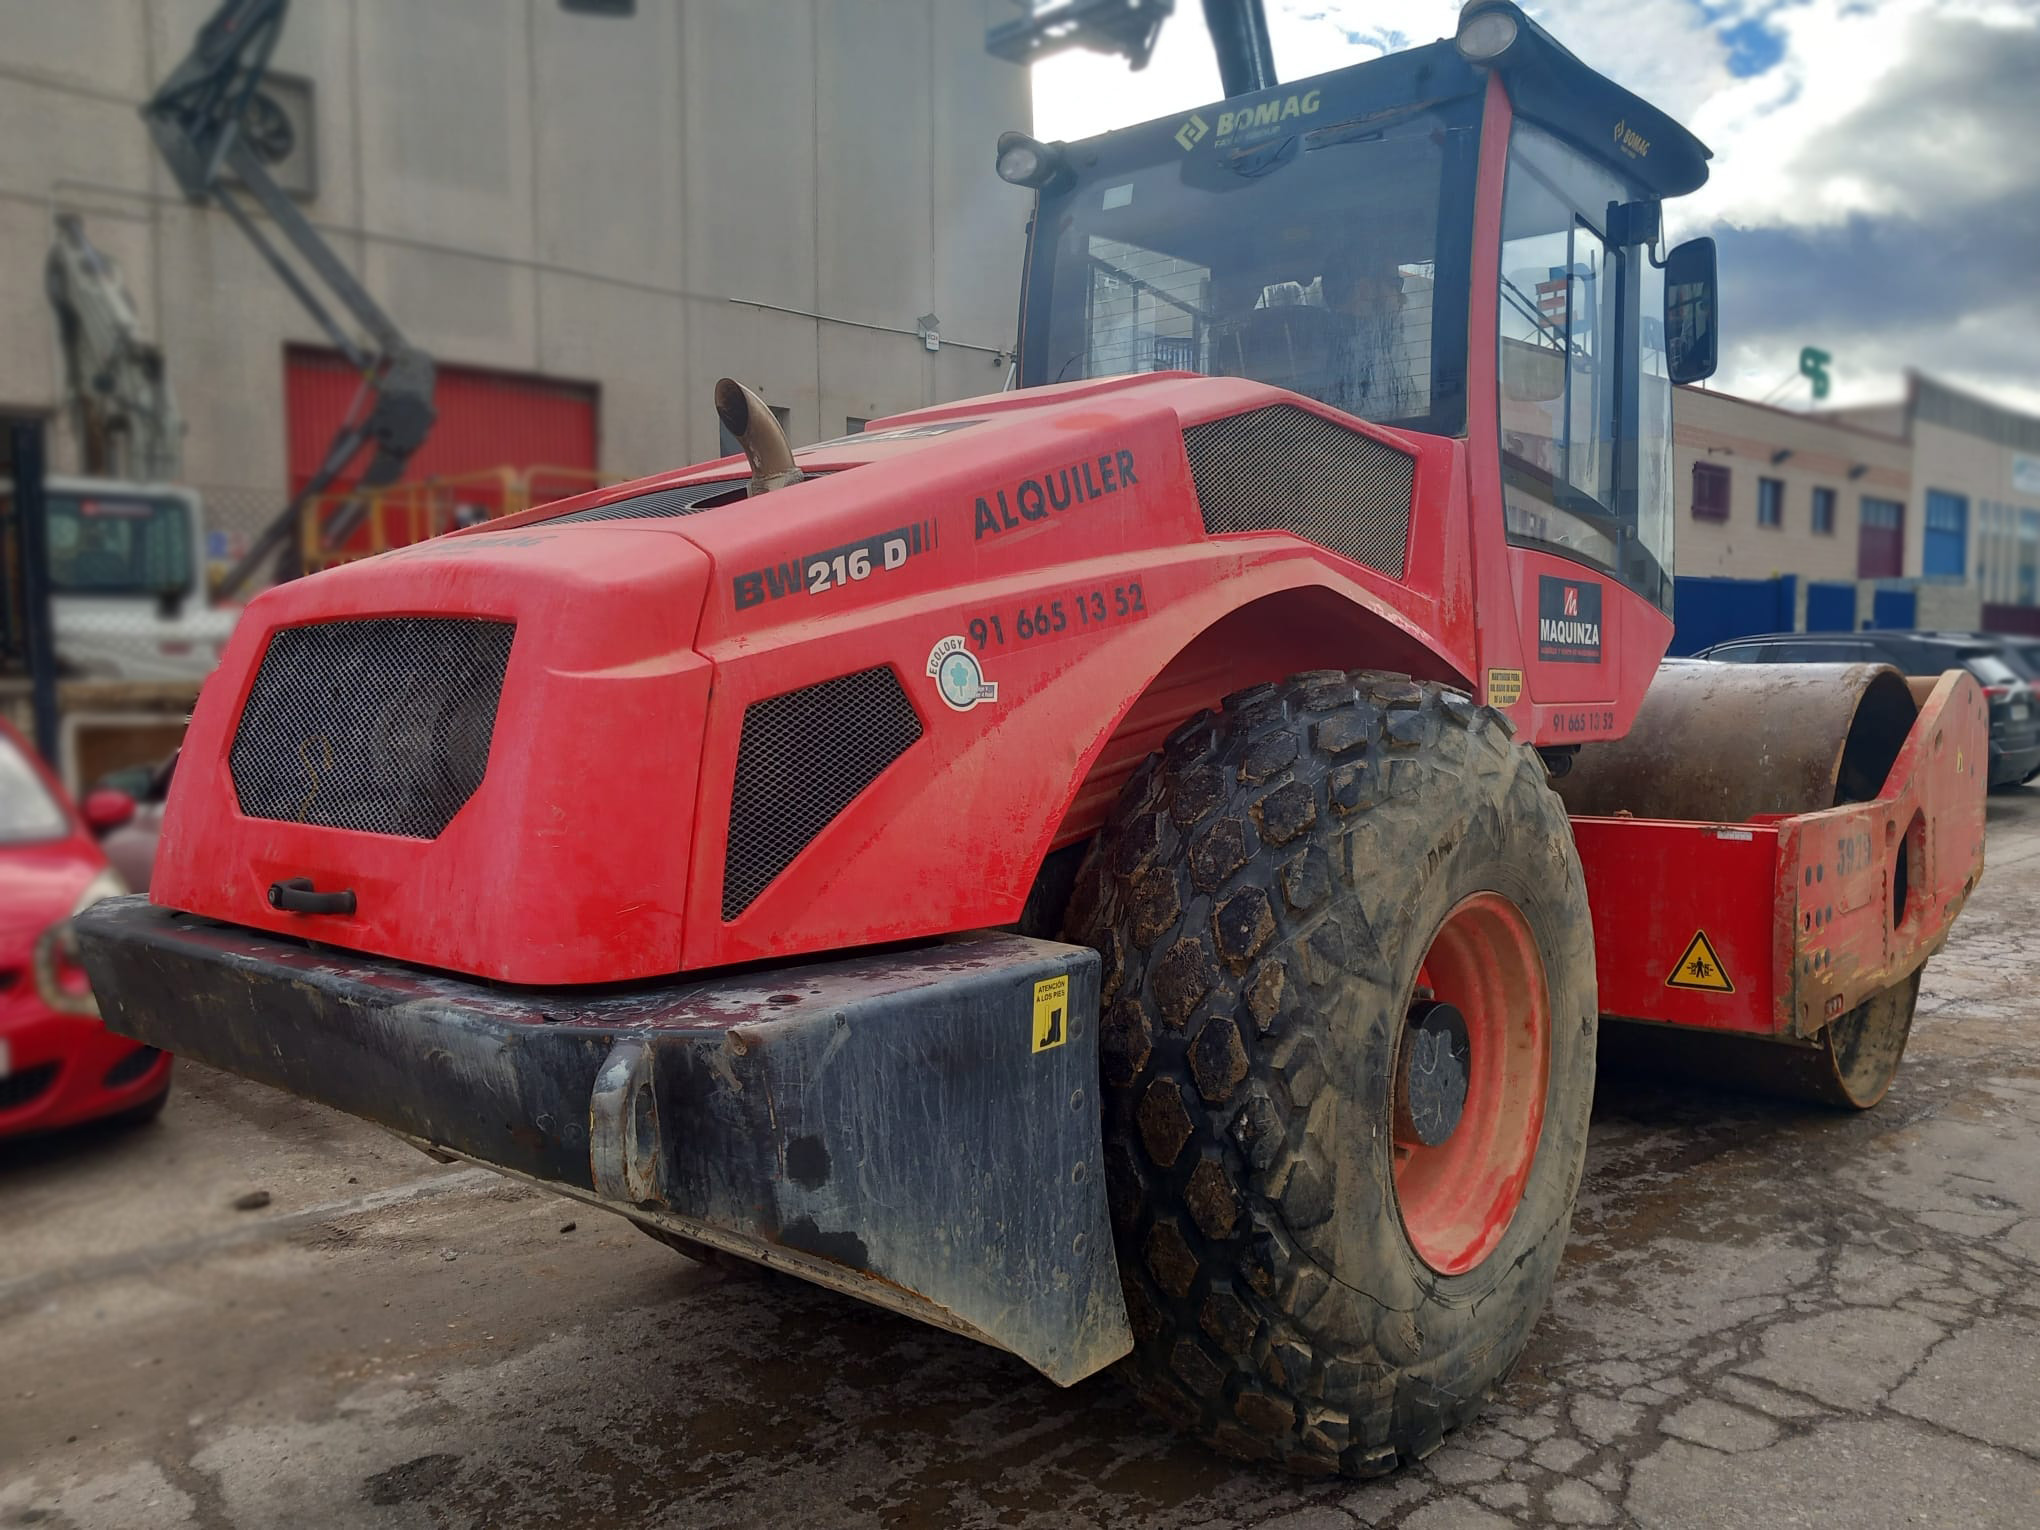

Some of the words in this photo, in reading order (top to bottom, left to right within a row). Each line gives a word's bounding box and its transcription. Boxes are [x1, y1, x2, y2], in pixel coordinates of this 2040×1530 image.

[1216, 90, 1320, 137] BOMAG
[1623, 128, 1650, 157] BOMAG
[975, 449, 1138, 540] ALQUILER
[733, 559, 801, 612] BW
[807, 548, 871, 596] 216
[883, 538, 908, 572] D
[969, 615, 1004, 649] 91
[1016, 605, 1067, 639] 665
[1076, 591, 1107, 624] 13
[1114, 583, 1145, 617] 52
[1540, 618, 1600, 645] MAQUINZA
[929, 639, 963, 675] ECOLOGY
[1553, 713, 1565, 732] 91
[1568, 712, 1586, 732] 665
[1602, 711, 1615, 731] 52
[1041, 992, 1053, 1002] LOS
[1053, 989, 1066, 999] PIES
